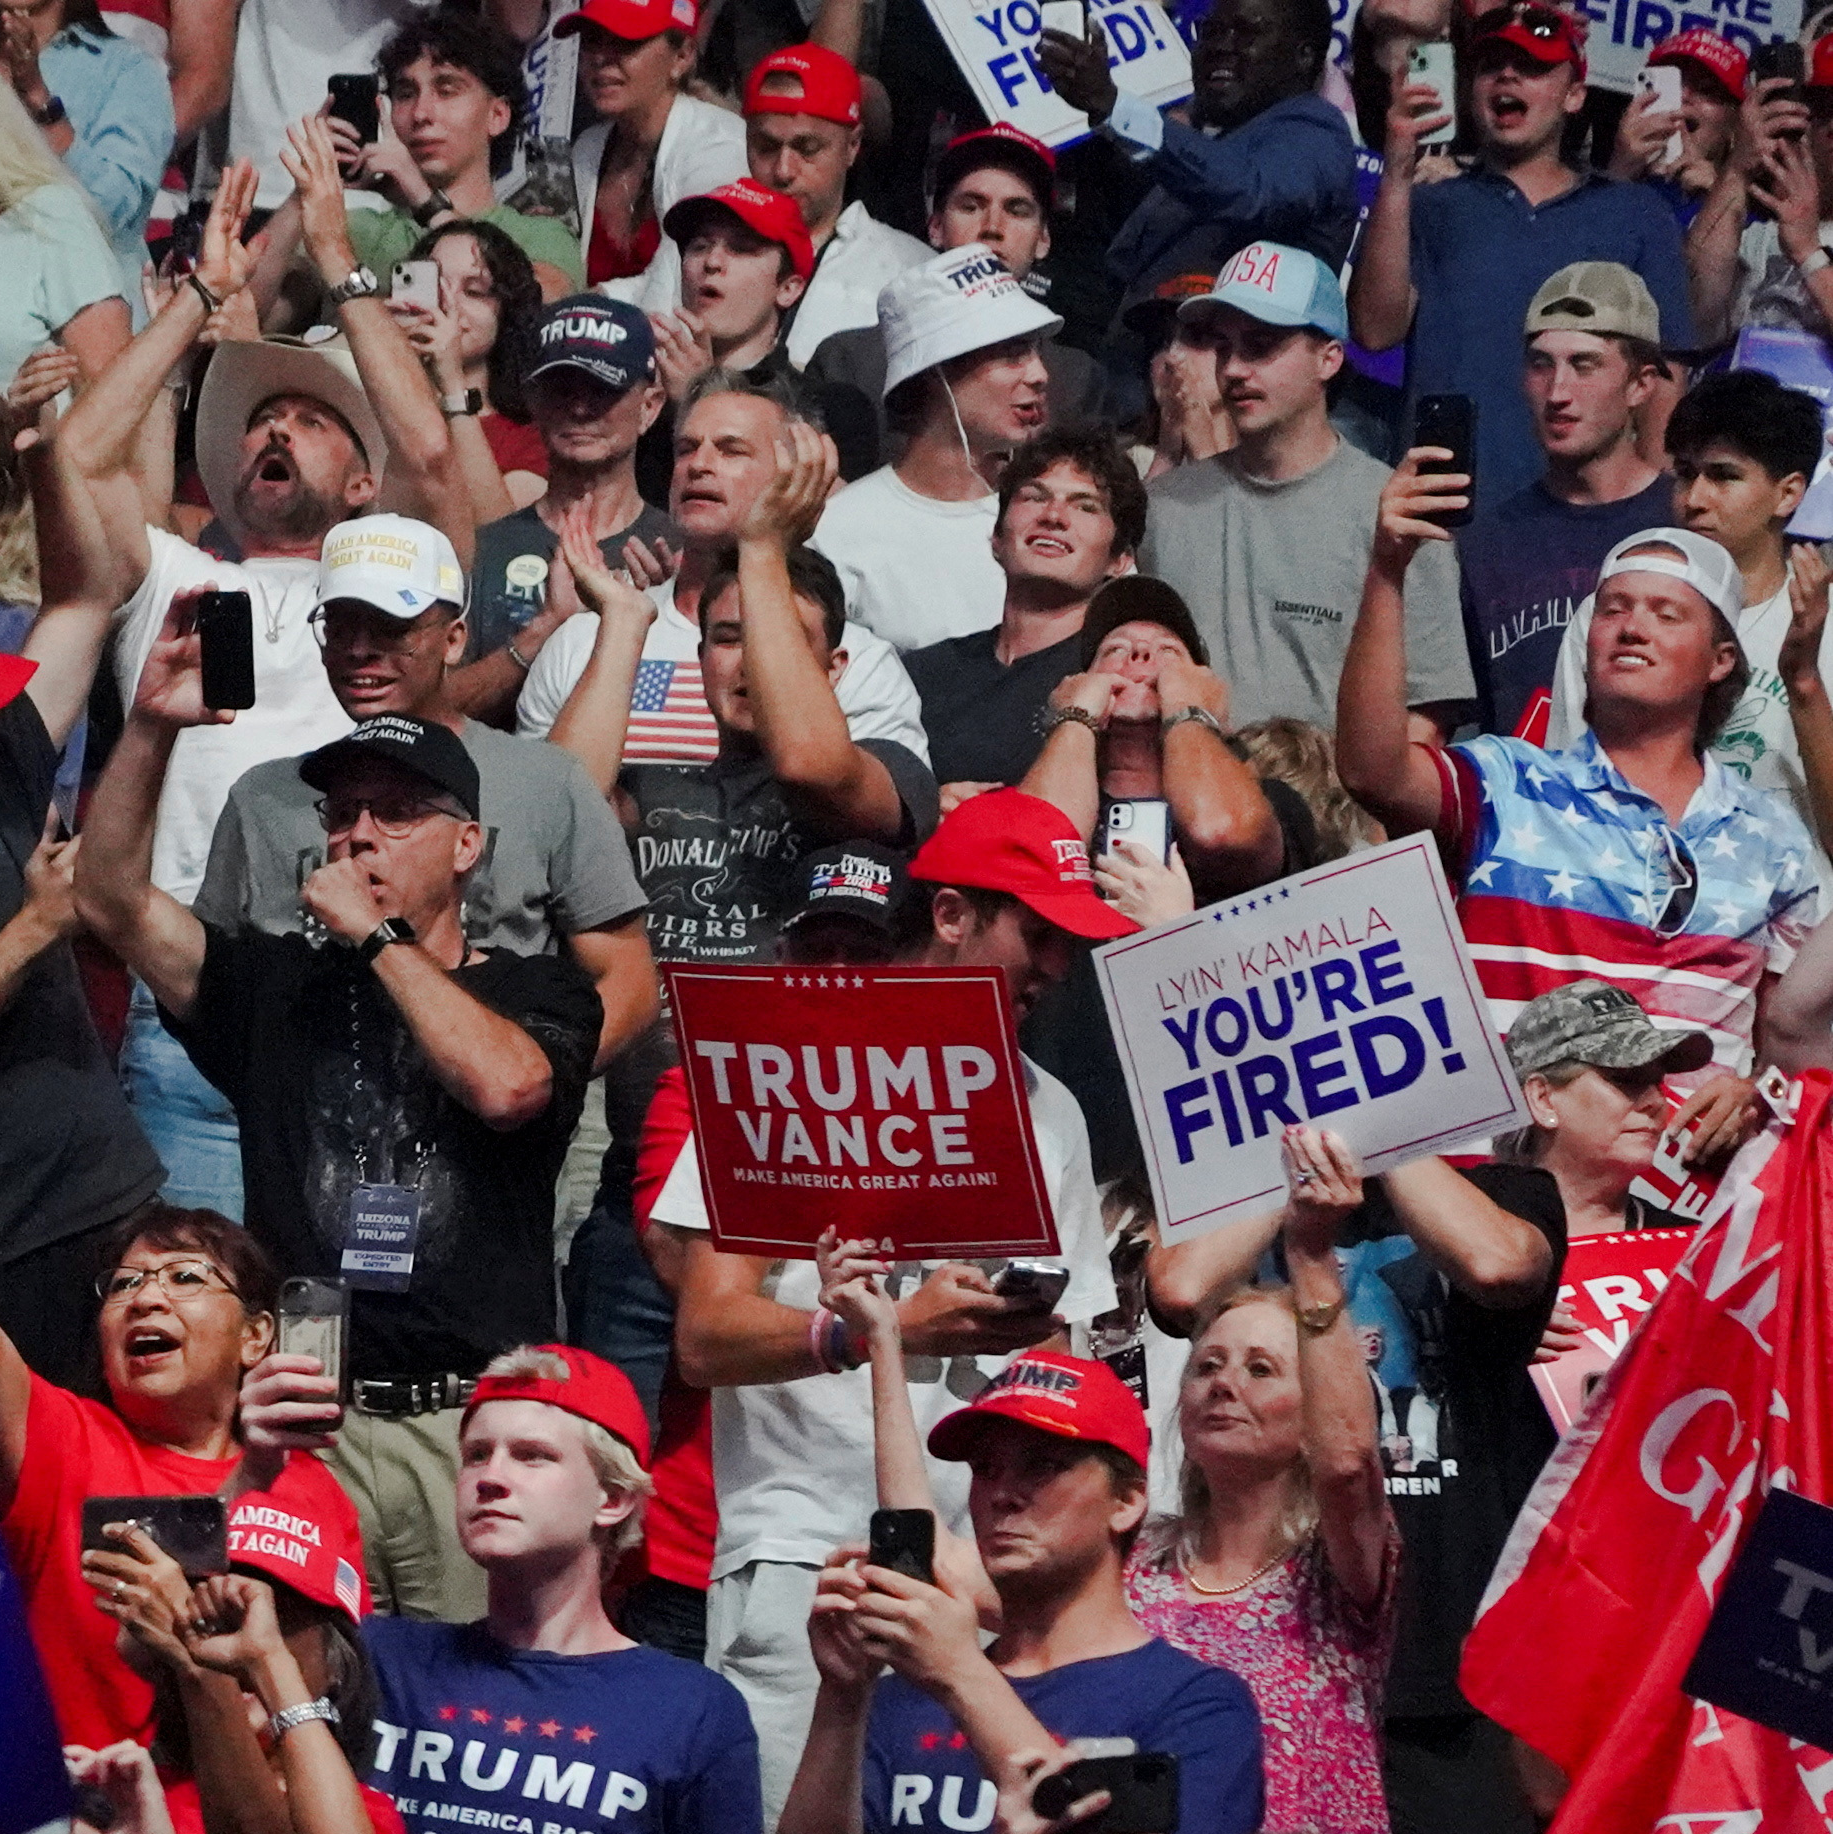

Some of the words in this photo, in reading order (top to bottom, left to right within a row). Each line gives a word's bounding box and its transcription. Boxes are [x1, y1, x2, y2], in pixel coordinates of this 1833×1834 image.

[986, 12, 1167, 107] FID!
[540, 316, 628, 347] TRUMP
[357, 532, 419, 556] AMERICA
[365, 551, 413, 571] AGAIN
[373, 715, 425, 736] AMERICA
[378, 728, 416, 744] AGAIN
[813, 859, 893, 884] Trump
[843, 873, 873, 889] 2020
[1156, 958, 1231, 1011] LYIN'
[1239, 905, 1394, 979] KAMALA
[1161, 940, 1414, 1072] YOU'RE
[694, 1040, 997, 1111] TRUMP
[1162, 995, 1469, 1164] FIRED!
[735, 1109, 975, 1168] VANCE
[733, 1166, 779, 1187] MAKE
[781, 1169, 855, 1190] AMERICA
[859, 1171, 922, 1190] GREAT
[927, 1170, 999, 1188] AGAIN!
[356, 1212, 411, 1226] ARIZONA
[356, 1228, 407, 1242] TRUMP
[229, 1504, 323, 1548] AMERICA
[242, 1531, 310, 1568] AGAIN
[371, 1716, 648, 1822] TRUMP
